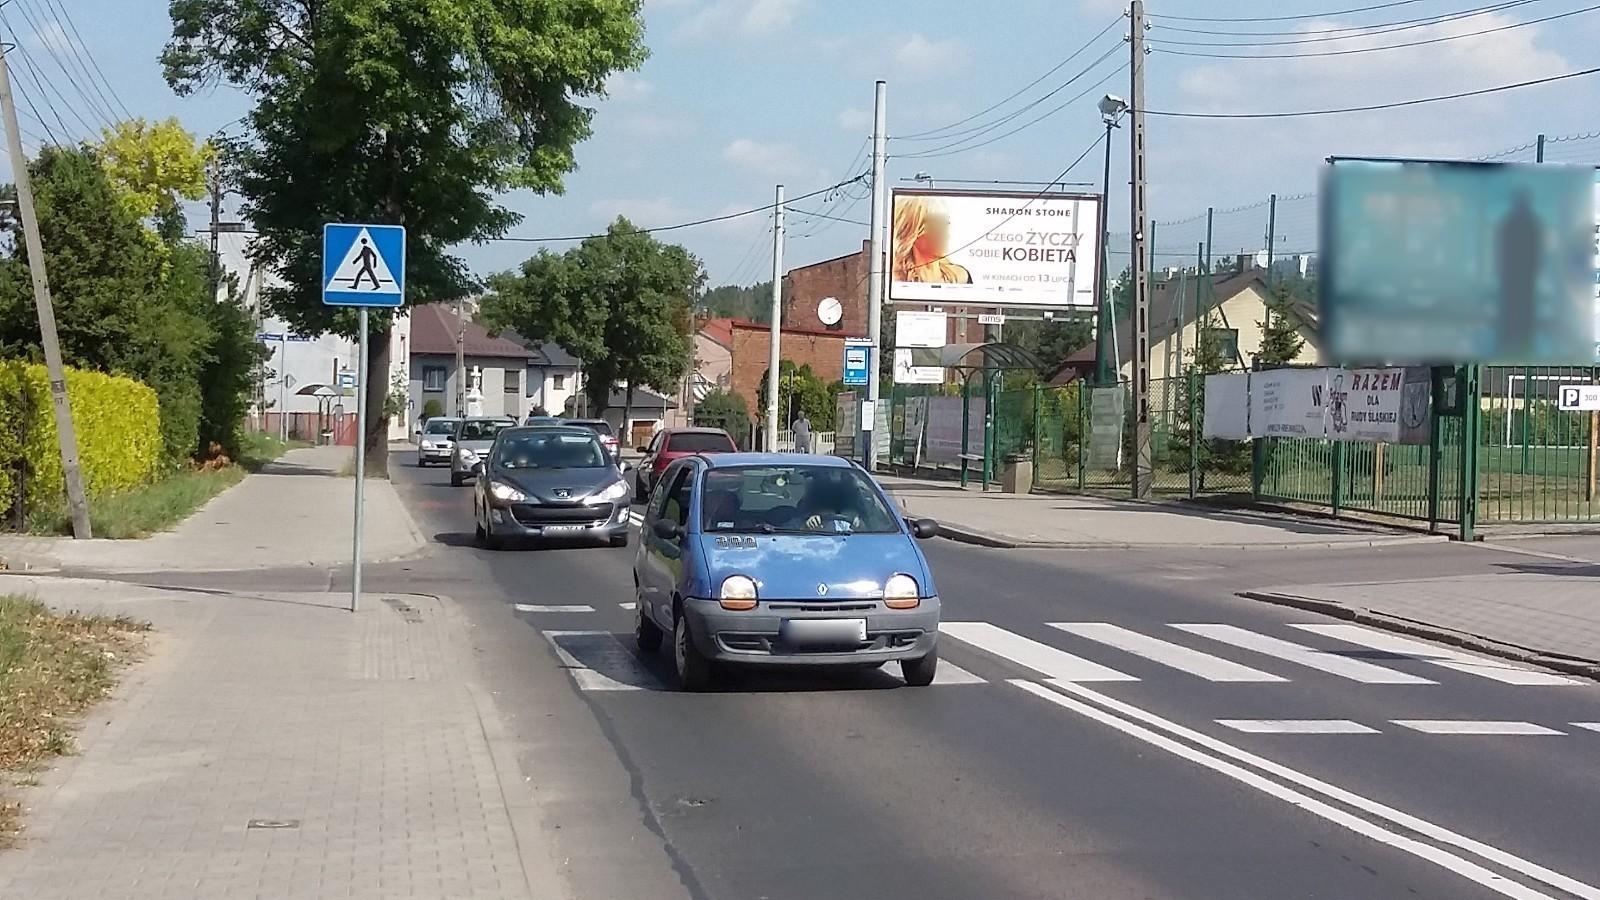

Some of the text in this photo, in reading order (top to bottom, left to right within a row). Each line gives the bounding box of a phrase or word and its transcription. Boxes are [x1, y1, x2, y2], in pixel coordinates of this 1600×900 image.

[985, 207, 1071, 217] SHARON STONE
[985, 228, 1084, 246] CZEGO ŻYCZY
[1002, 247, 1077, 263] KOBIETA
[1038, 274, 1050, 283] 13
[1351, 372, 1402, 391] RAZEM
[1366, 394, 1380, 406] DLA
